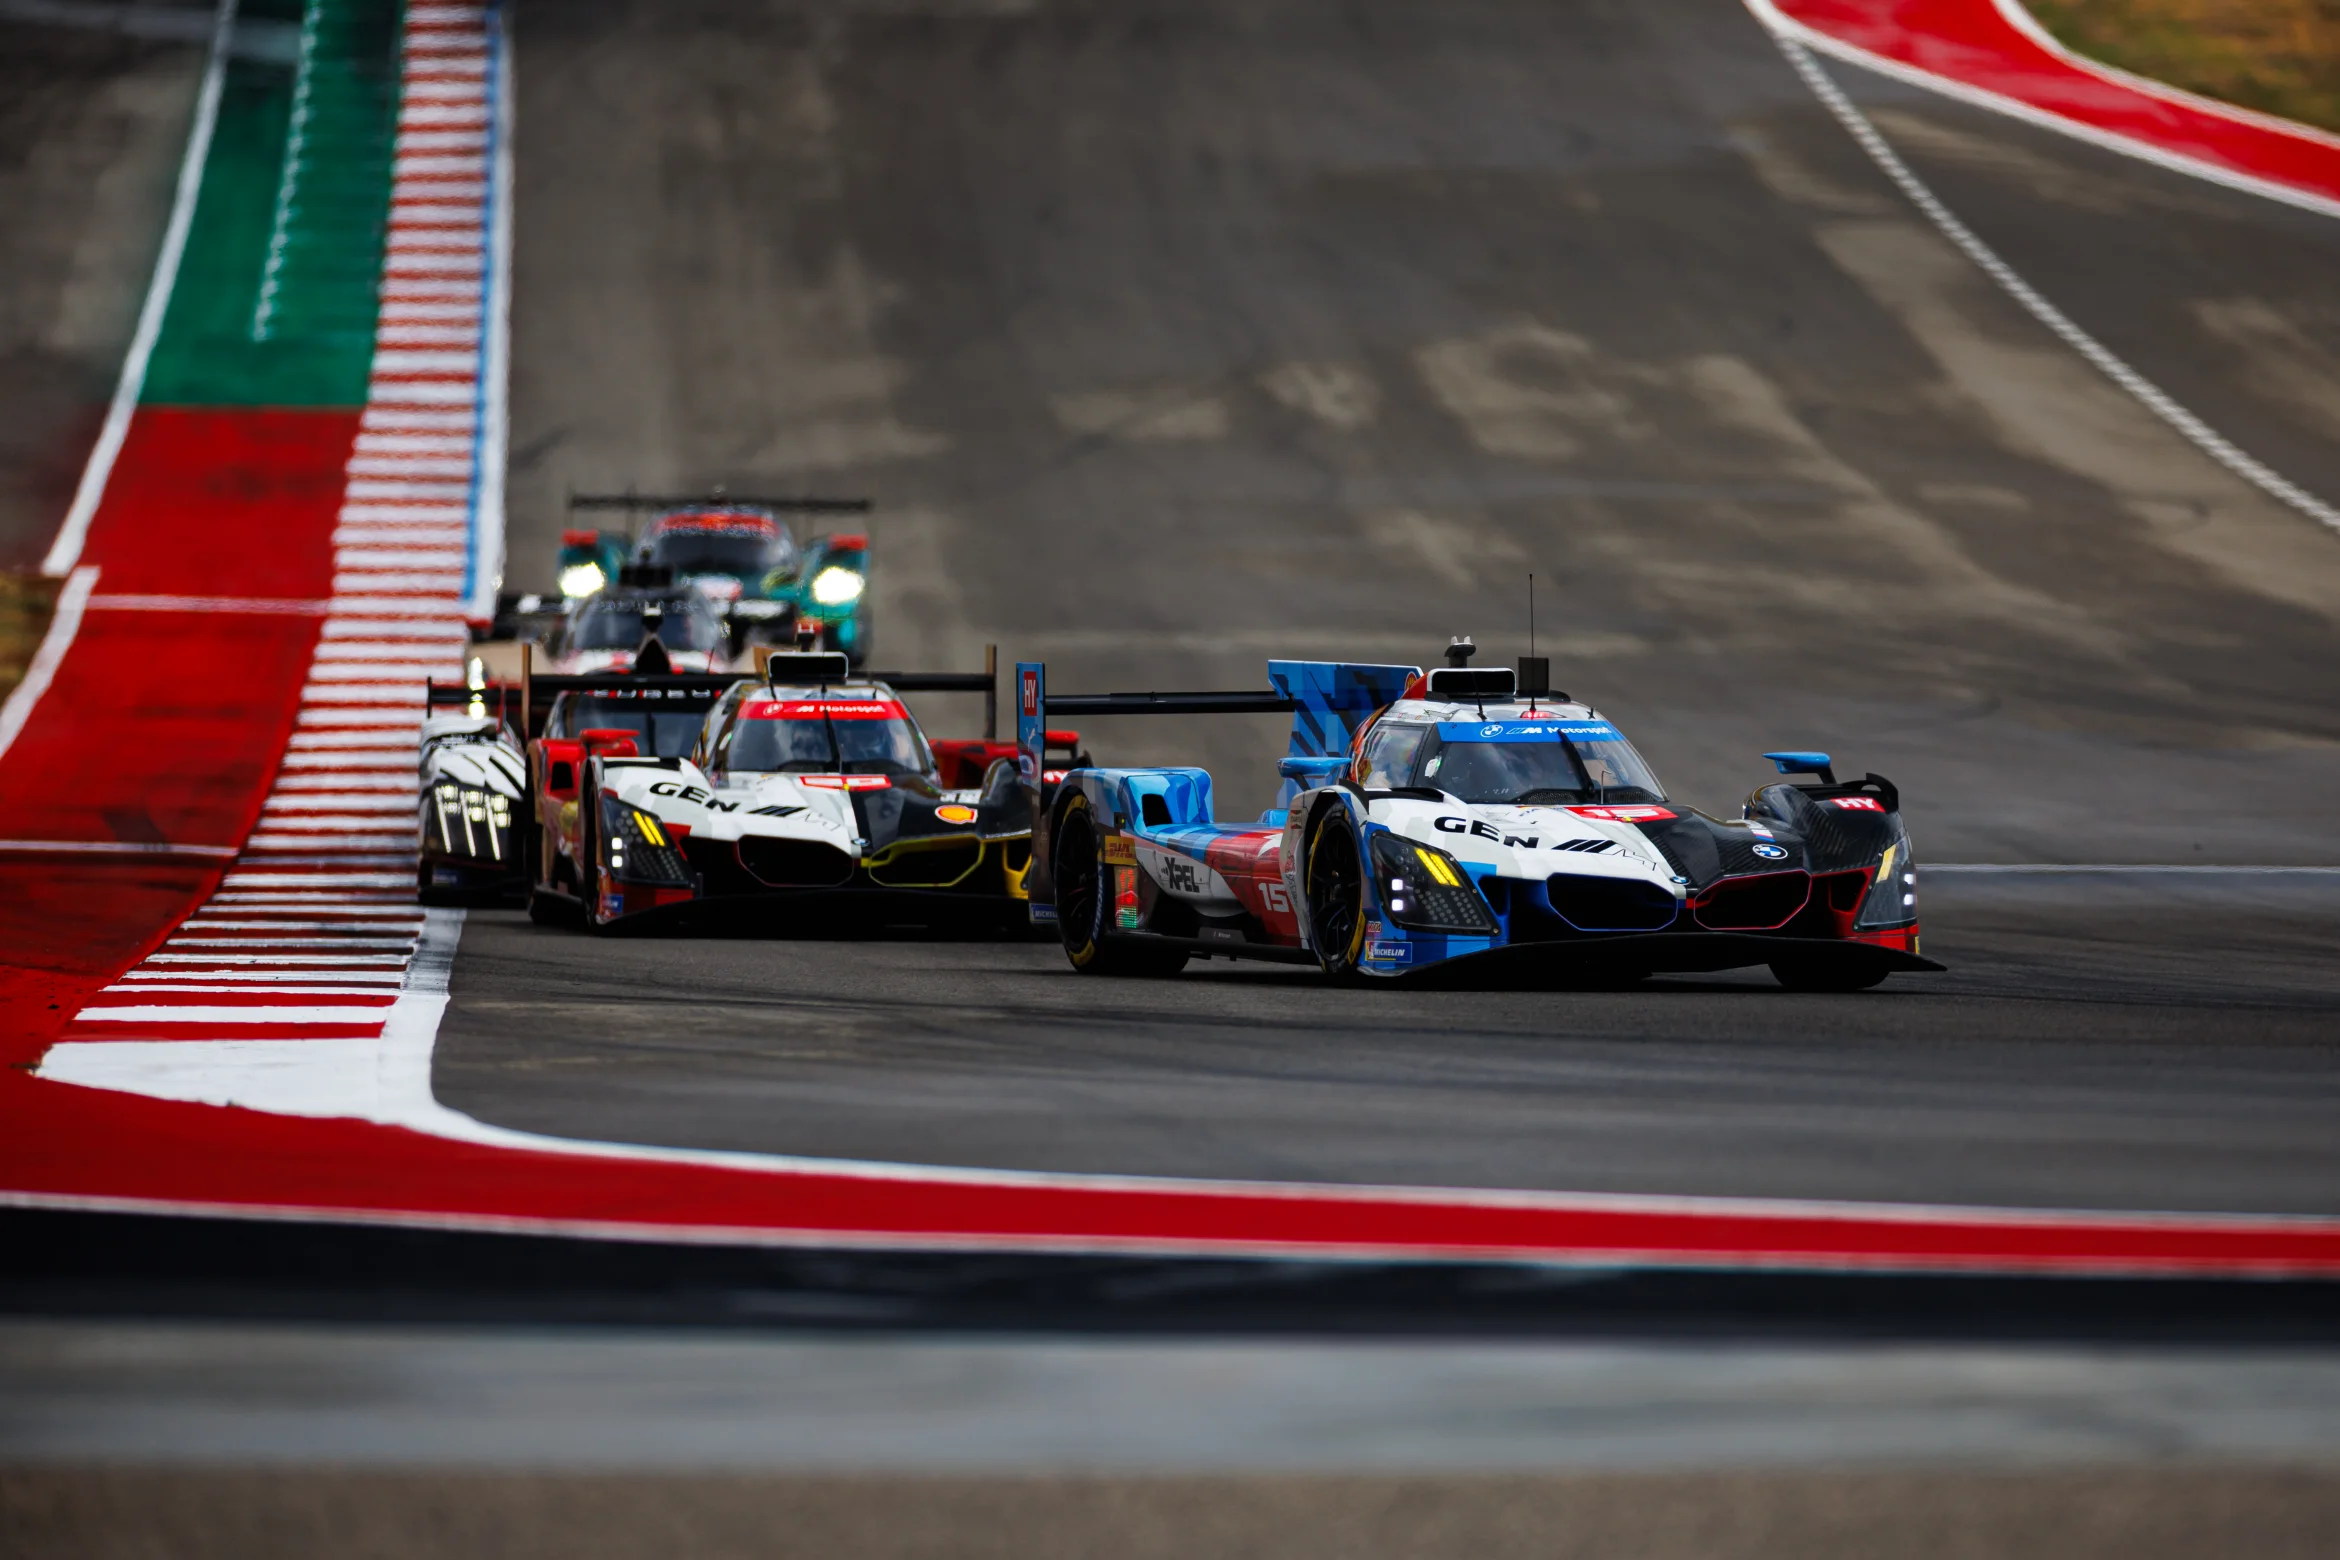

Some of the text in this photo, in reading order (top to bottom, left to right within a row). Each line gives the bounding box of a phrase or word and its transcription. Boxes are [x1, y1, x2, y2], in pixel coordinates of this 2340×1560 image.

[1024, 680, 1036, 708] HY
[649, 782, 740, 812] GEN
[1834, 798, 1877, 809] HY
[1433, 816, 1540, 849] GEN
[1164, 857, 1200, 893] XPEL
[1258, 882, 1289, 913] 15
[1035, 909, 1058, 918] MICHEL
[1374, 948, 1405, 957] MICHELIN
